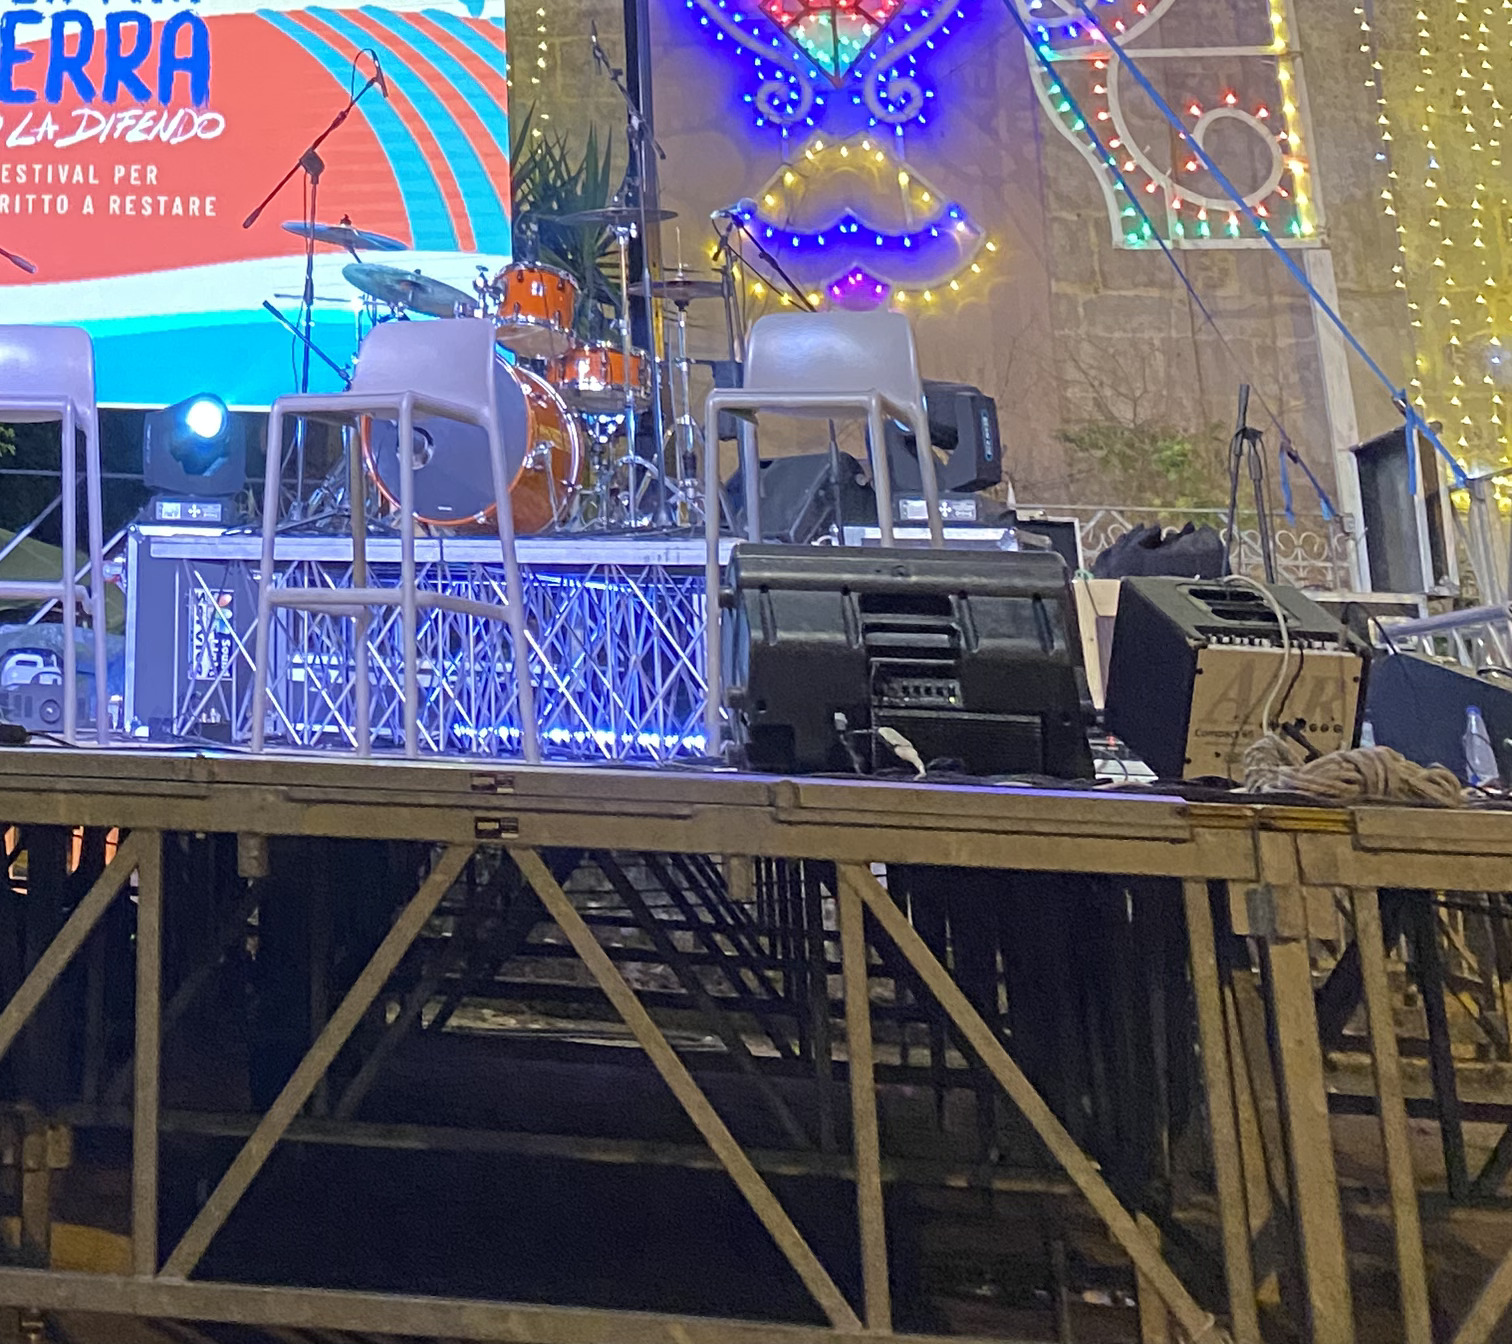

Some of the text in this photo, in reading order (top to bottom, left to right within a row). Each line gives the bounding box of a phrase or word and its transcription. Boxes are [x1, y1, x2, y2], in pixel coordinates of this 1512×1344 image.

[6, 110, 60, 147] LA
[54, 108, 226, 147] DIFENDO
[114, 164, 158, 185] PER
[82, 195, 94, 215] A
[109, 195, 217, 216] RESTARE
